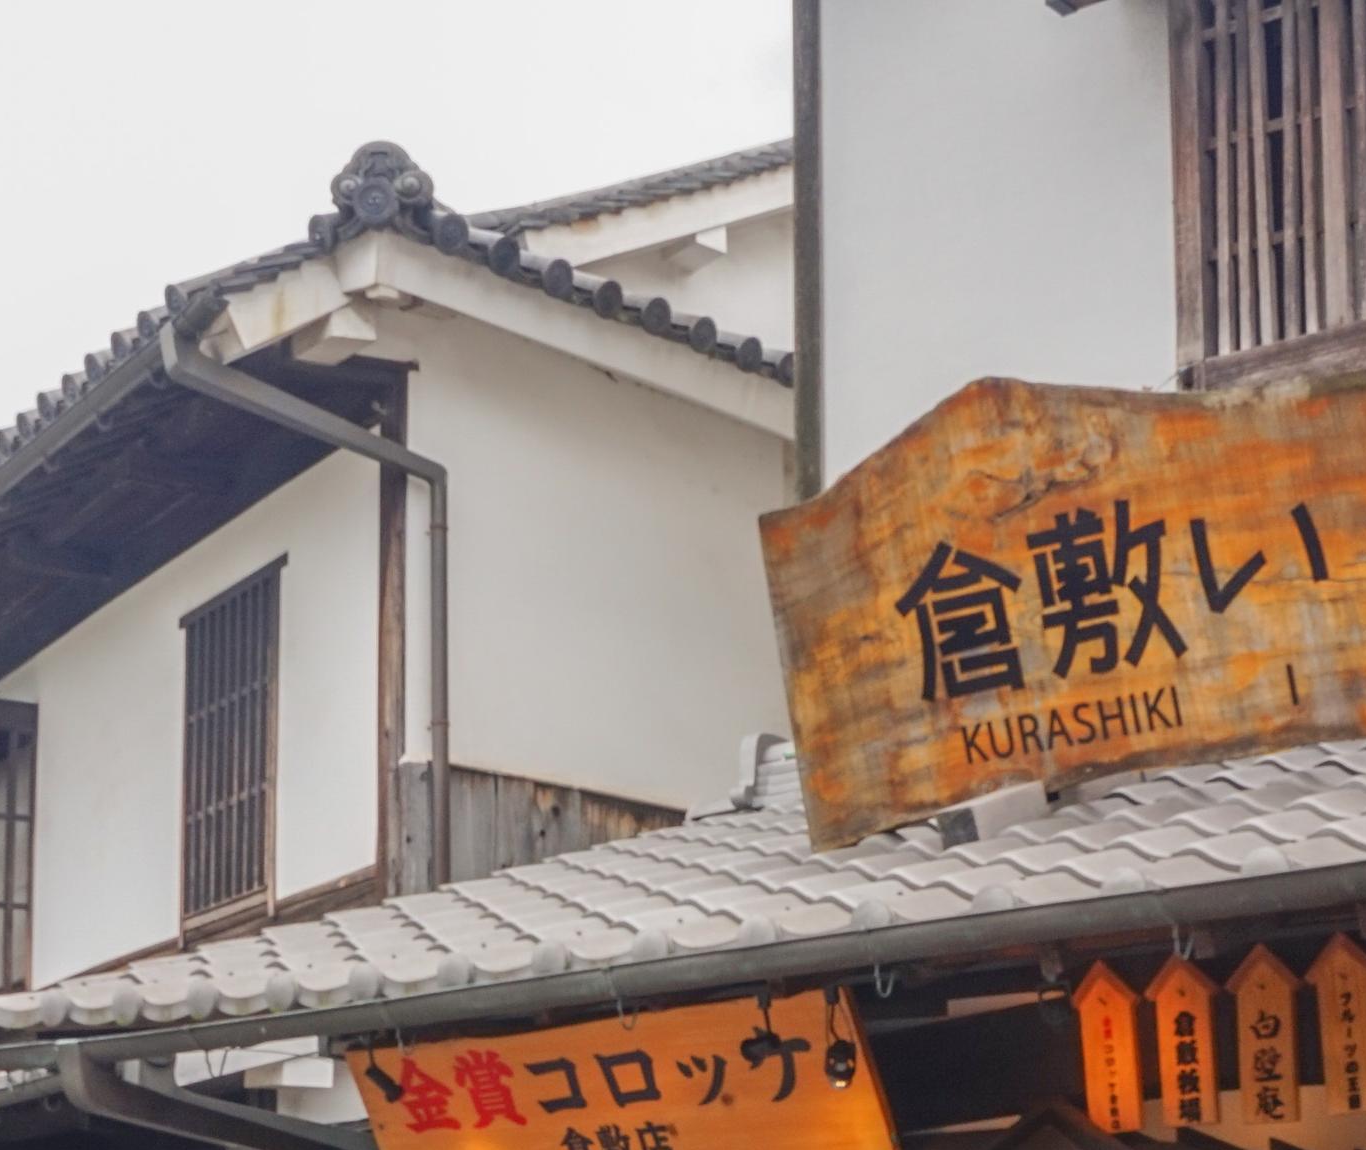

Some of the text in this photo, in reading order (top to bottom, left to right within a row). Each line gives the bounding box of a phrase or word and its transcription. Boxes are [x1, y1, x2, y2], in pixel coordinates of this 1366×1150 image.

[961, 691, 1185, 767] KURASHIKI
[1288, 659, 1300, 707] I
[398, 1035, 812, 1135] 金賞コロッケ
